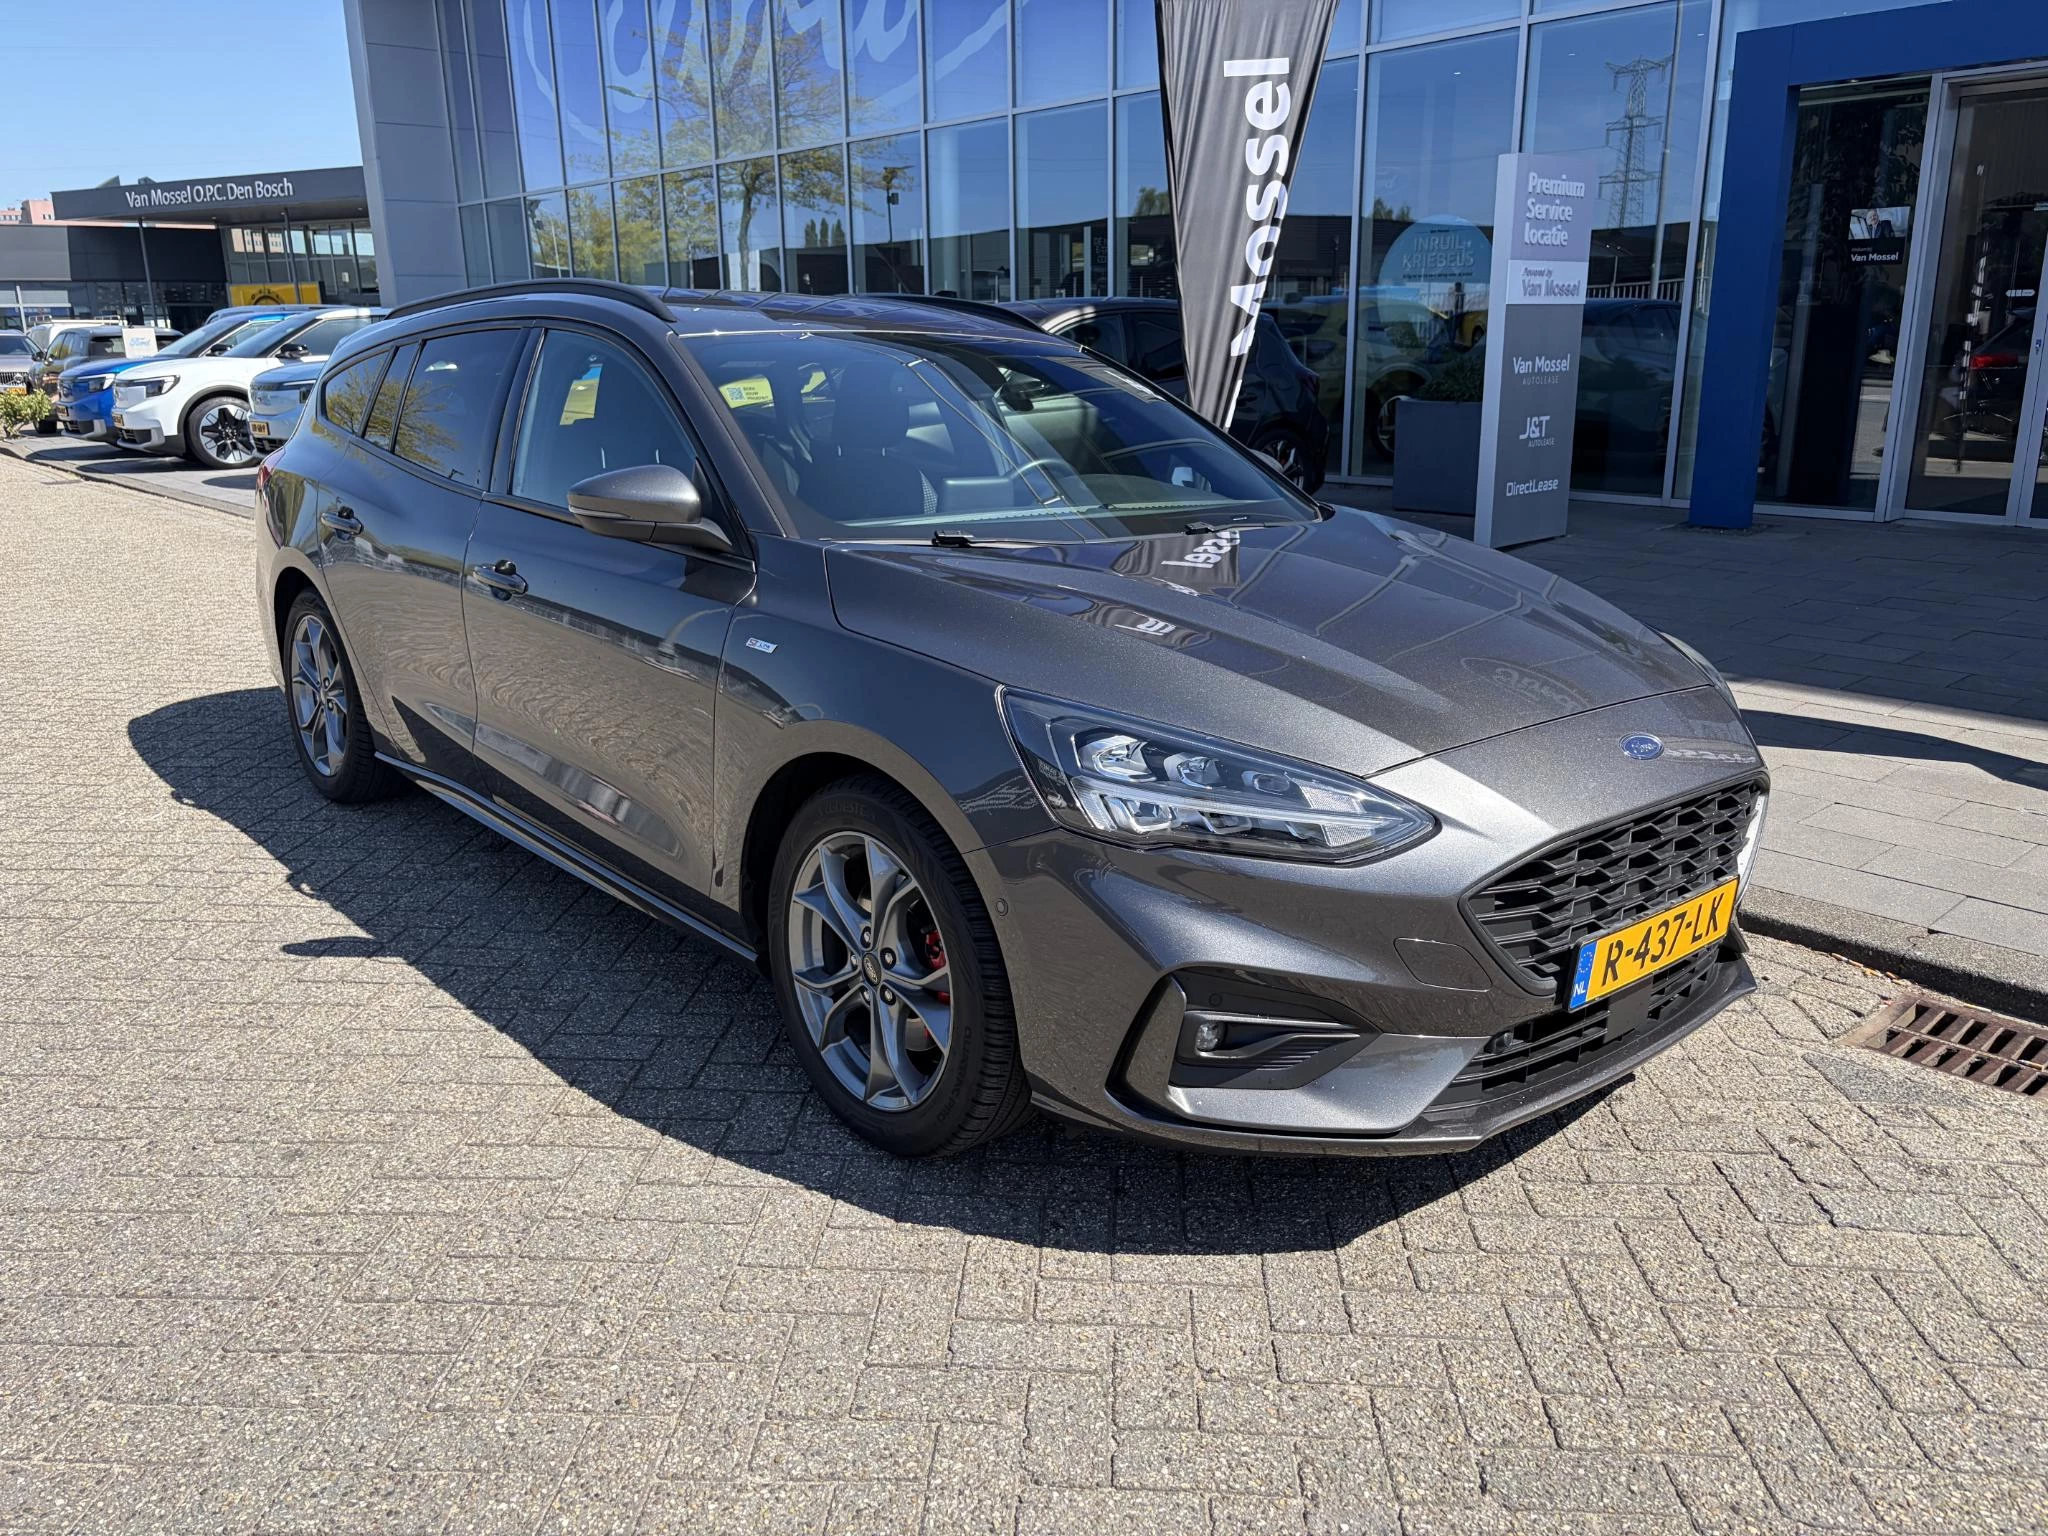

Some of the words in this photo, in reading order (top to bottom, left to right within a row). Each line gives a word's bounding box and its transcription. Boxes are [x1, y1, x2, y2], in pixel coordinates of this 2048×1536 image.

[125, 191, 149, 208] Van
[150, 185, 192, 207] Mossel
[193, 183, 226, 203] O.P.C.
[227, 182, 253, 200] Den
[255, 178, 293, 198] Bosch
[1527, 172, 1585, 198] Premium
[1223, 56, 1292, 358] Mossel
[1526, 198, 1573, 221] Service
[1524, 222, 1568, 247] locatie
[1851, 253, 1867, 262] Van
[1868, 251, 1899, 261] Mossel
[1522, 279, 1542, 297] Van
[1544, 279, 1581, 297] Mossel
[1513, 356, 1532, 374] Van
[1534, 353, 1570, 373] Mossel
[1522, 375, 1559, 385] AUTOLEASE
[1519, 415, 1550, 440] J&T
[1528, 437, 1555, 448] AUTOLEASE
[1506, 478, 1559, 497] DirectLease
[1601, 893, 1724, 987] R-437-LK
[1573, 981, 1586, 997] NL
